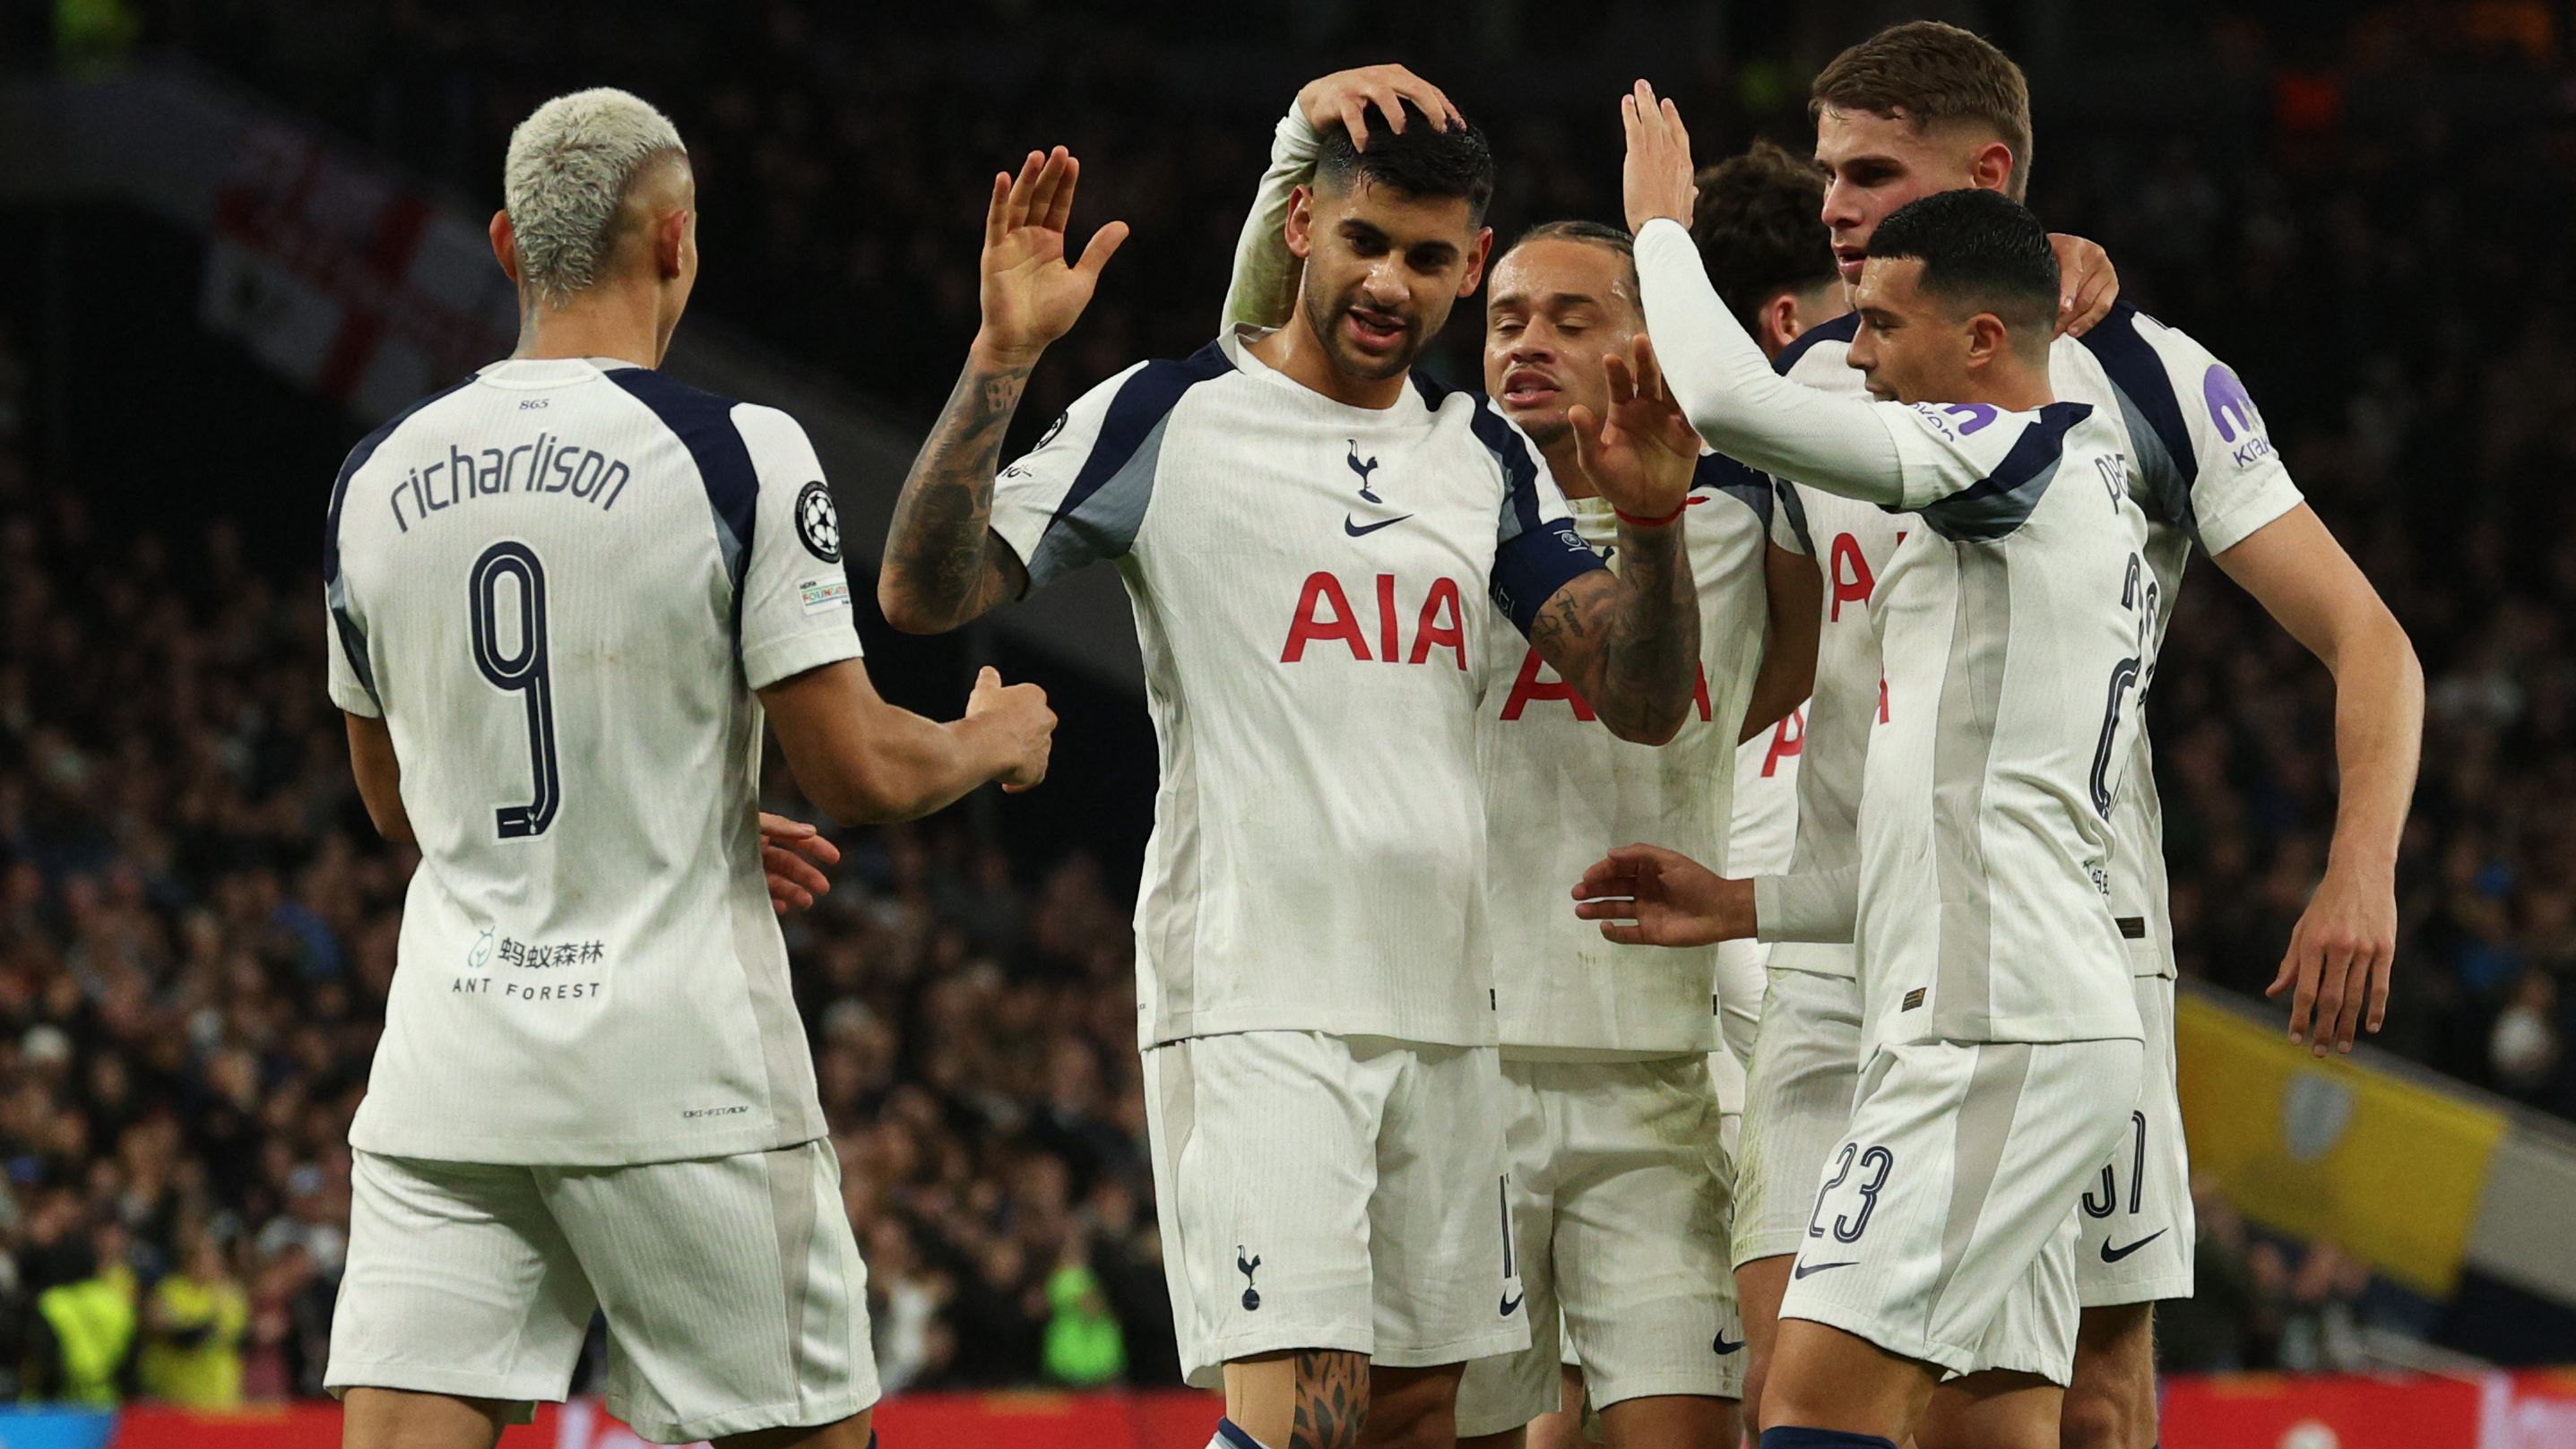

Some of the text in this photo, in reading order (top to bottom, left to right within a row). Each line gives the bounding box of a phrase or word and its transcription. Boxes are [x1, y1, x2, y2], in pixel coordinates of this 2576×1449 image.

[518, 398, 550, 410] 865
[390, 432, 630, 533] richarlison
[1280, 570, 1467, 671] AIA
[469, 540, 559, 839] 9
[452, 977, 601, 1000] ANT FOREST
[497, 936, 605, 969] 蚂蚁森林
[1808, 1141, 1895, 1244] 23
